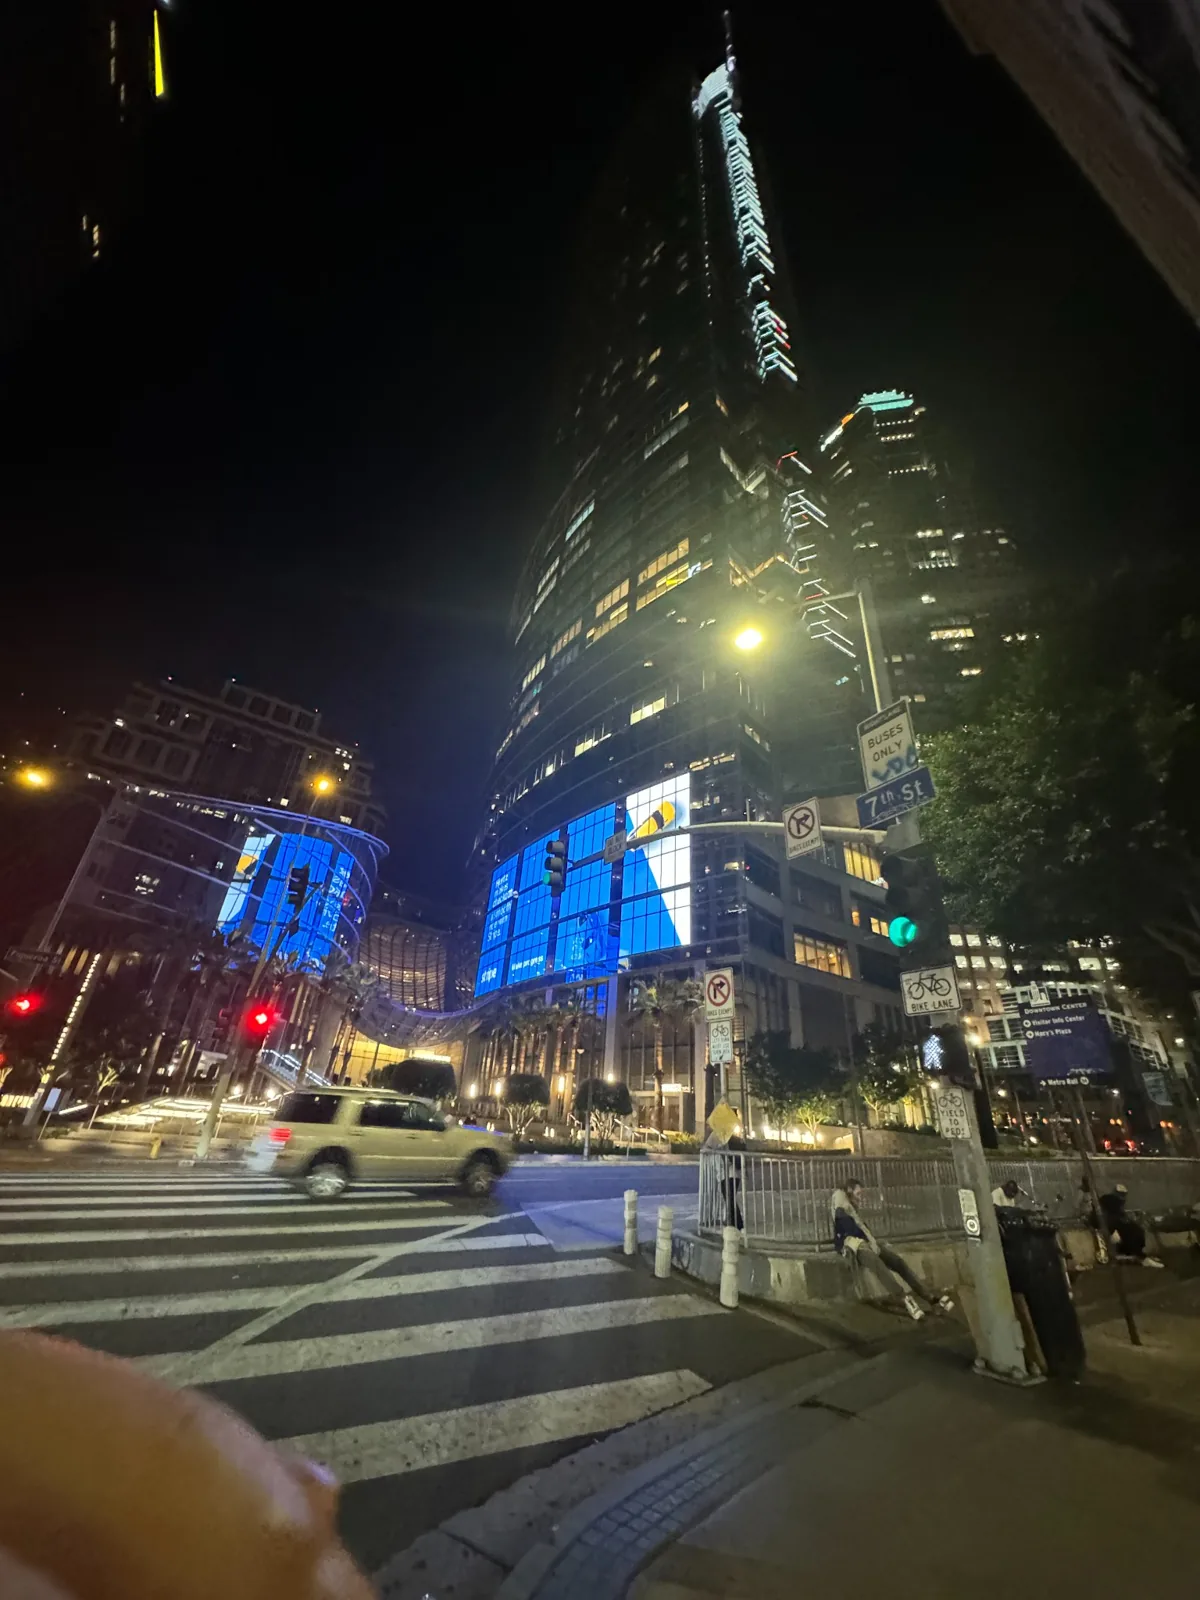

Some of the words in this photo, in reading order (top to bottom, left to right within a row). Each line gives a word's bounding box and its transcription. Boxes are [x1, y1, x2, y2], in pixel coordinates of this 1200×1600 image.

[867, 723, 904, 749] BUSES
[872, 739, 902, 762] ONLY
[864, 790, 894, 817] 7th
[901, 779, 924, 801] St
[911, 1001, 930, 1013] BIKE
[932, 998, 954, 1010] LANE
[1023, 1005, 1061, 1015] DOWNTOWN
[1061, 1002, 1088, 1010] CENTER
[1064, 1015, 1085, 1023] Center
[1047, 1078, 1066, 1086] Metro
[939, 1109, 965, 1118] YIELD
[949, 1118, 959, 1126] TO
